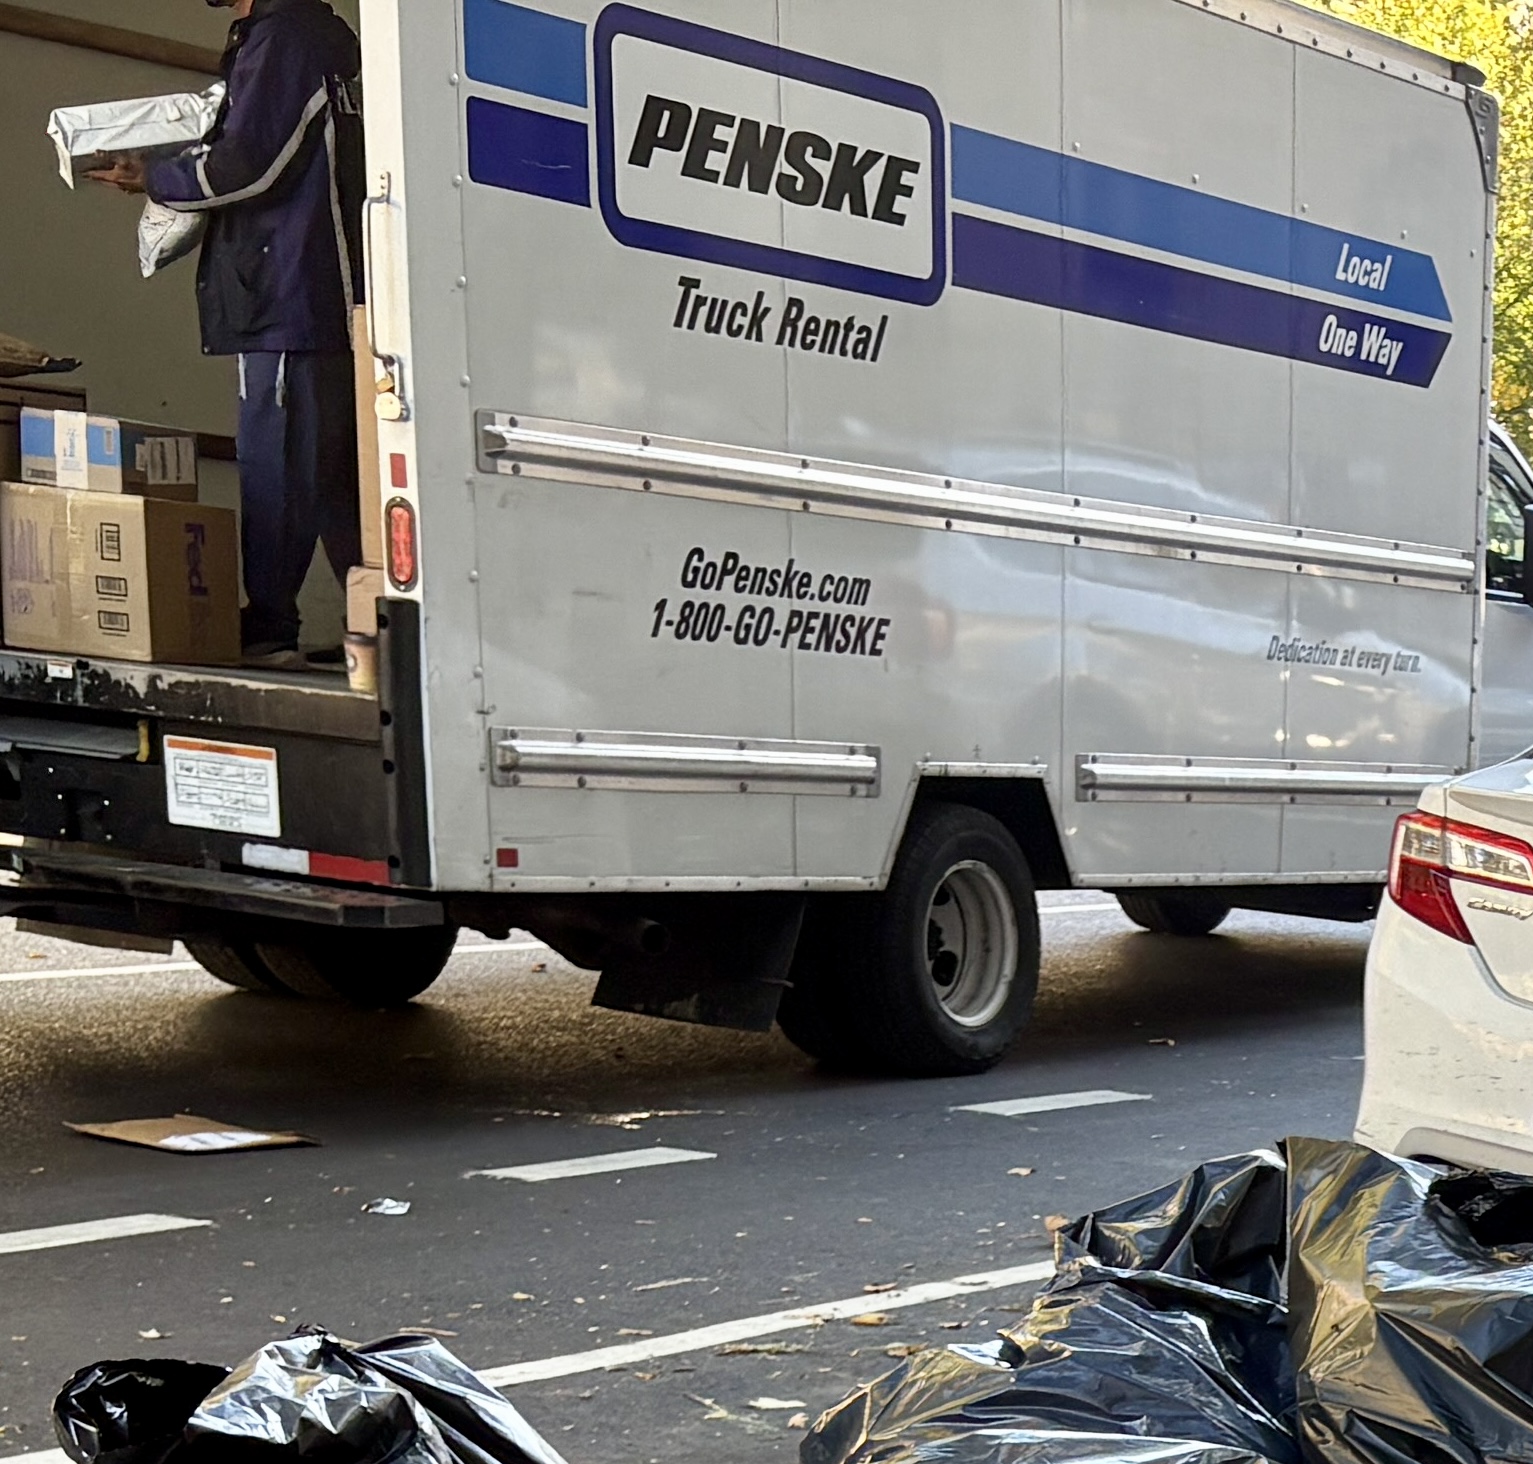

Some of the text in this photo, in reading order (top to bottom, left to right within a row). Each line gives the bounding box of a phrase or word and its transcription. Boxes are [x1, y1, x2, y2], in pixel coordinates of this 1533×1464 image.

[628, 94, 920, 227] PENSKE
[1335, 243, 1392, 292] Local
[673, 276, 888, 363] Truck Rental
[1318, 313, 1403, 375] One Way
[681, 547, 870, 607] GoPenske.com
[650, 599, 890, 657] 1-800-GO-PENSKE
[1266, 635, 1422, 676] Dedication at every turn.
